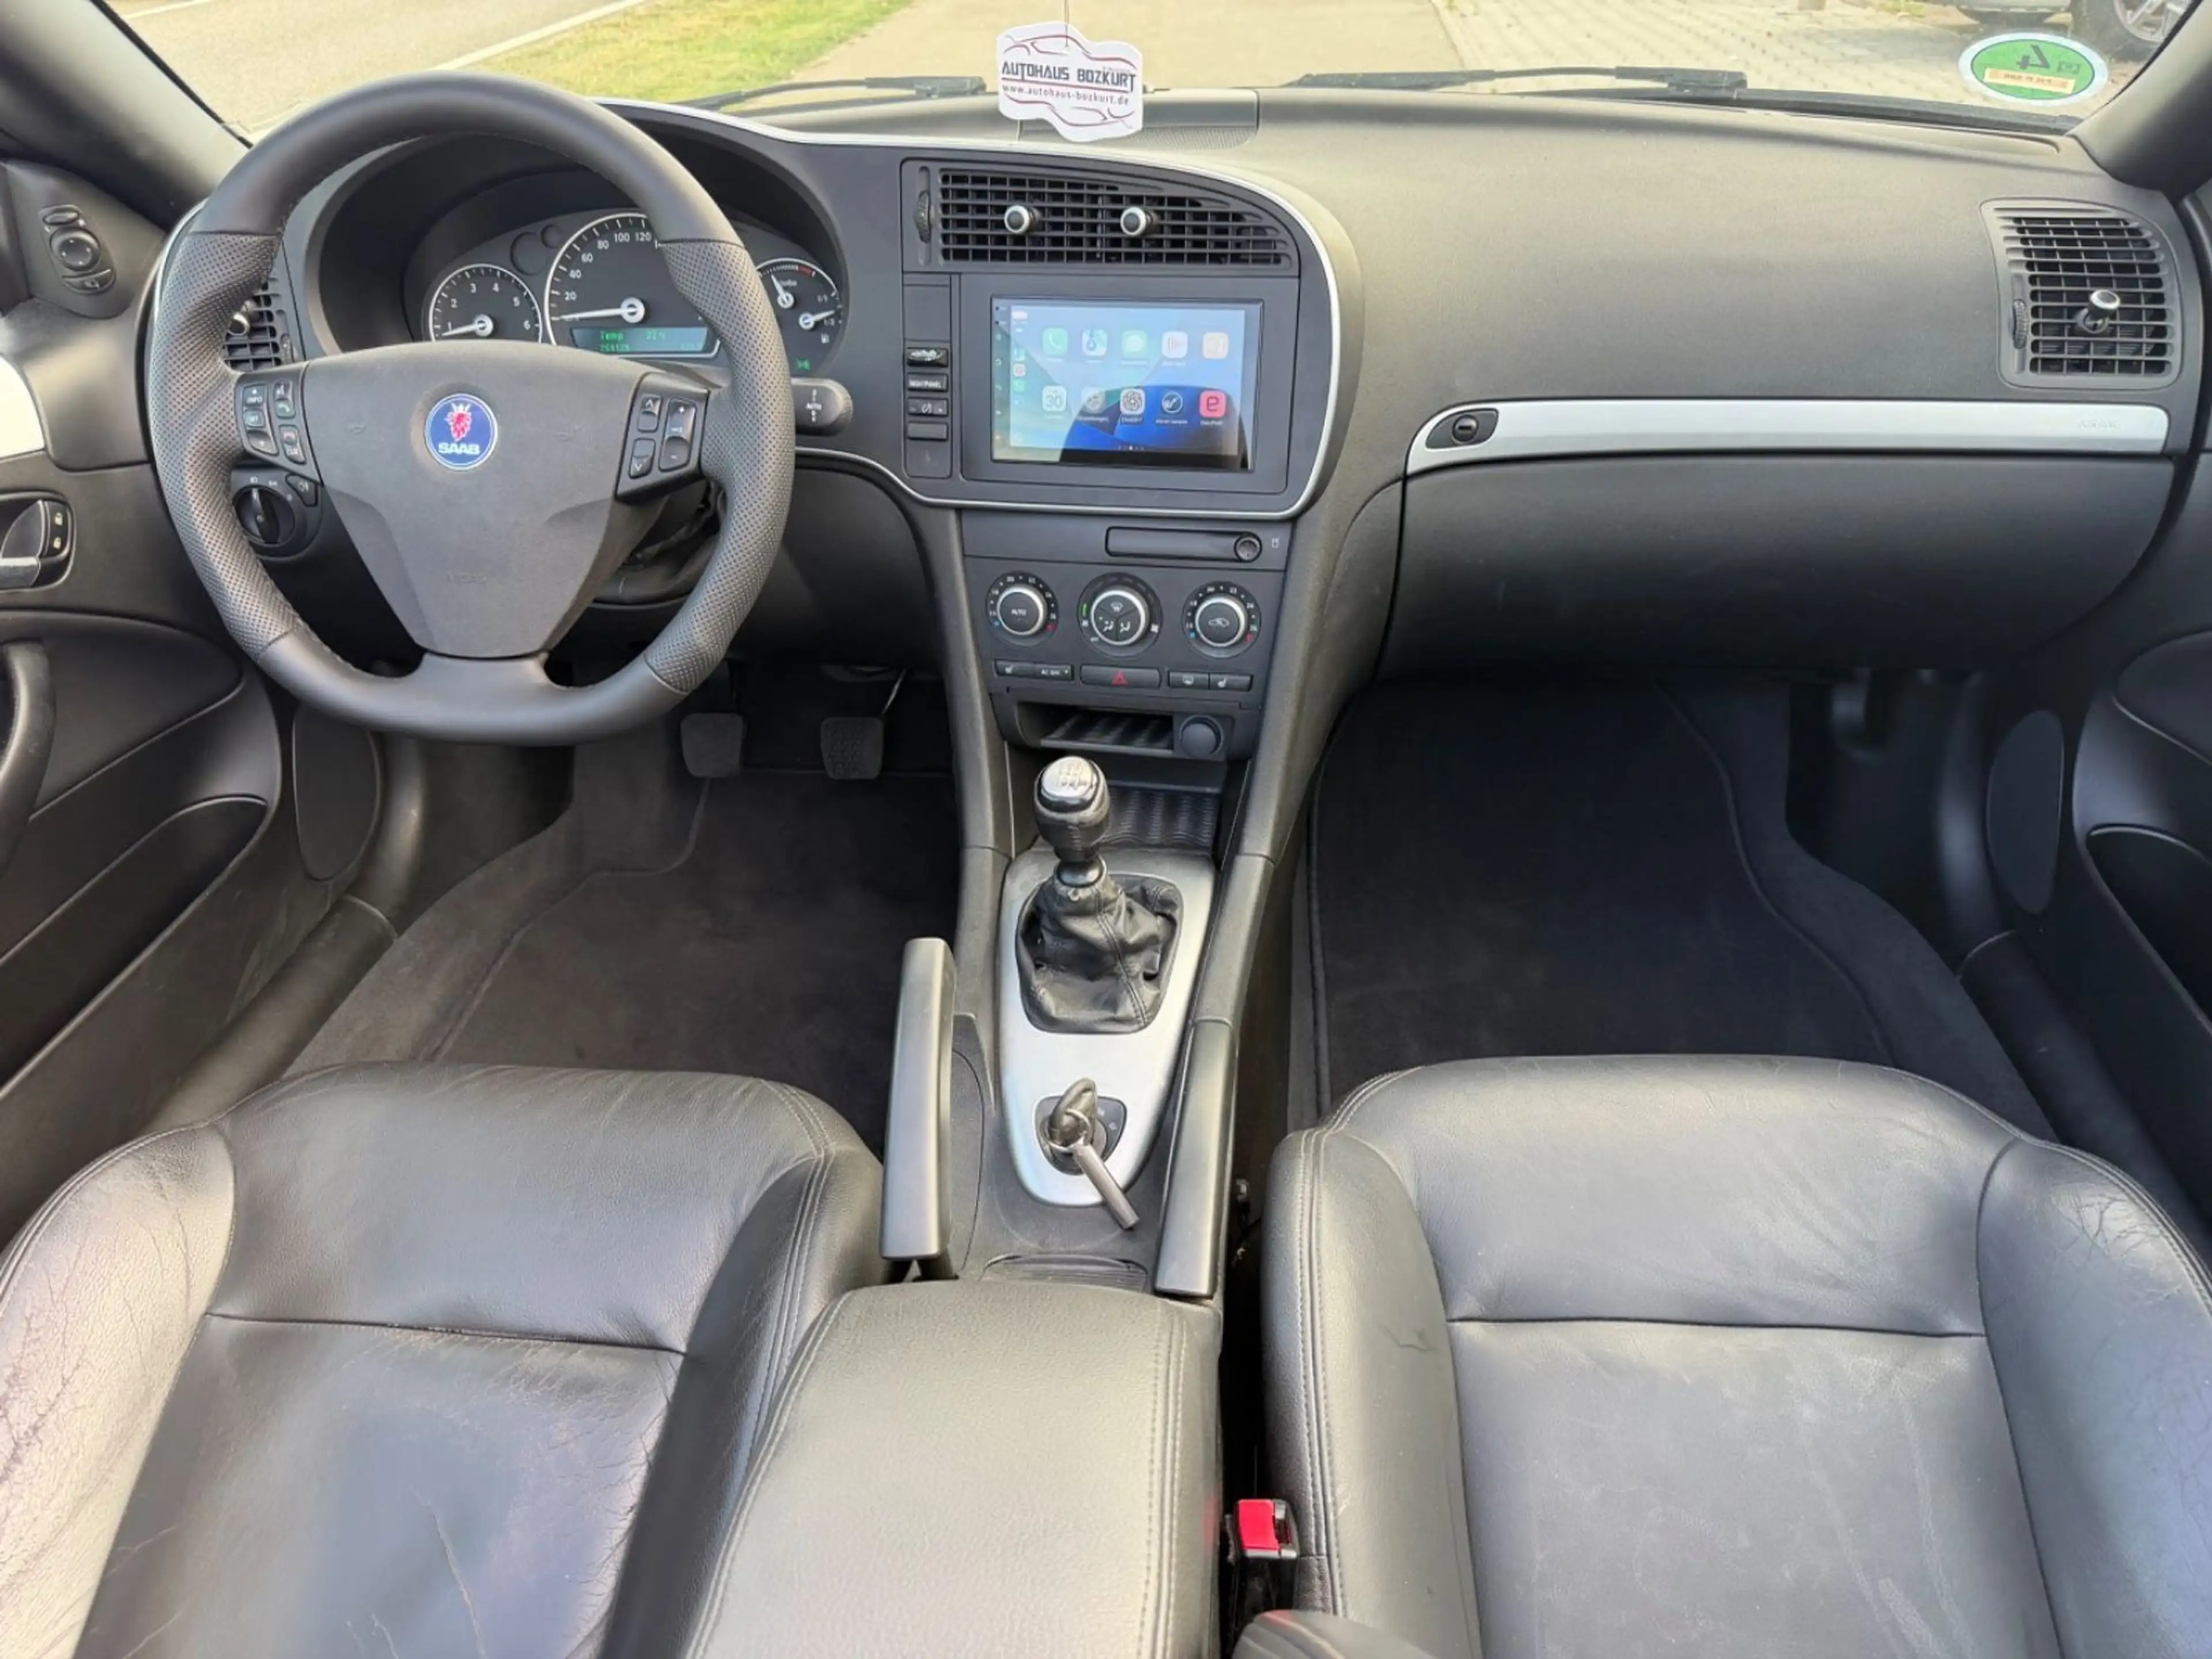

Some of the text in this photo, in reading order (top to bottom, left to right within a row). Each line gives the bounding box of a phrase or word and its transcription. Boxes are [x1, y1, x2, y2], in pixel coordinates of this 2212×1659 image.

[1002, 60, 1136, 92] AUTOHAUS BOZKURT
[613, 232, 630, 242] 100
[635, 232, 652, 242] 120
[597, 240, 609, 249] 80
[581, 253, 594, 263] 60
[470, 283, 476, 293] 3
[493, 282, 499, 293] 4
[565, 291, 577, 301] 20
[451, 298, 458, 308] 2
[513, 297, 520, 307] 5
[524, 320, 531, 330] 6
[438, 442, 480, 455] SAAB
